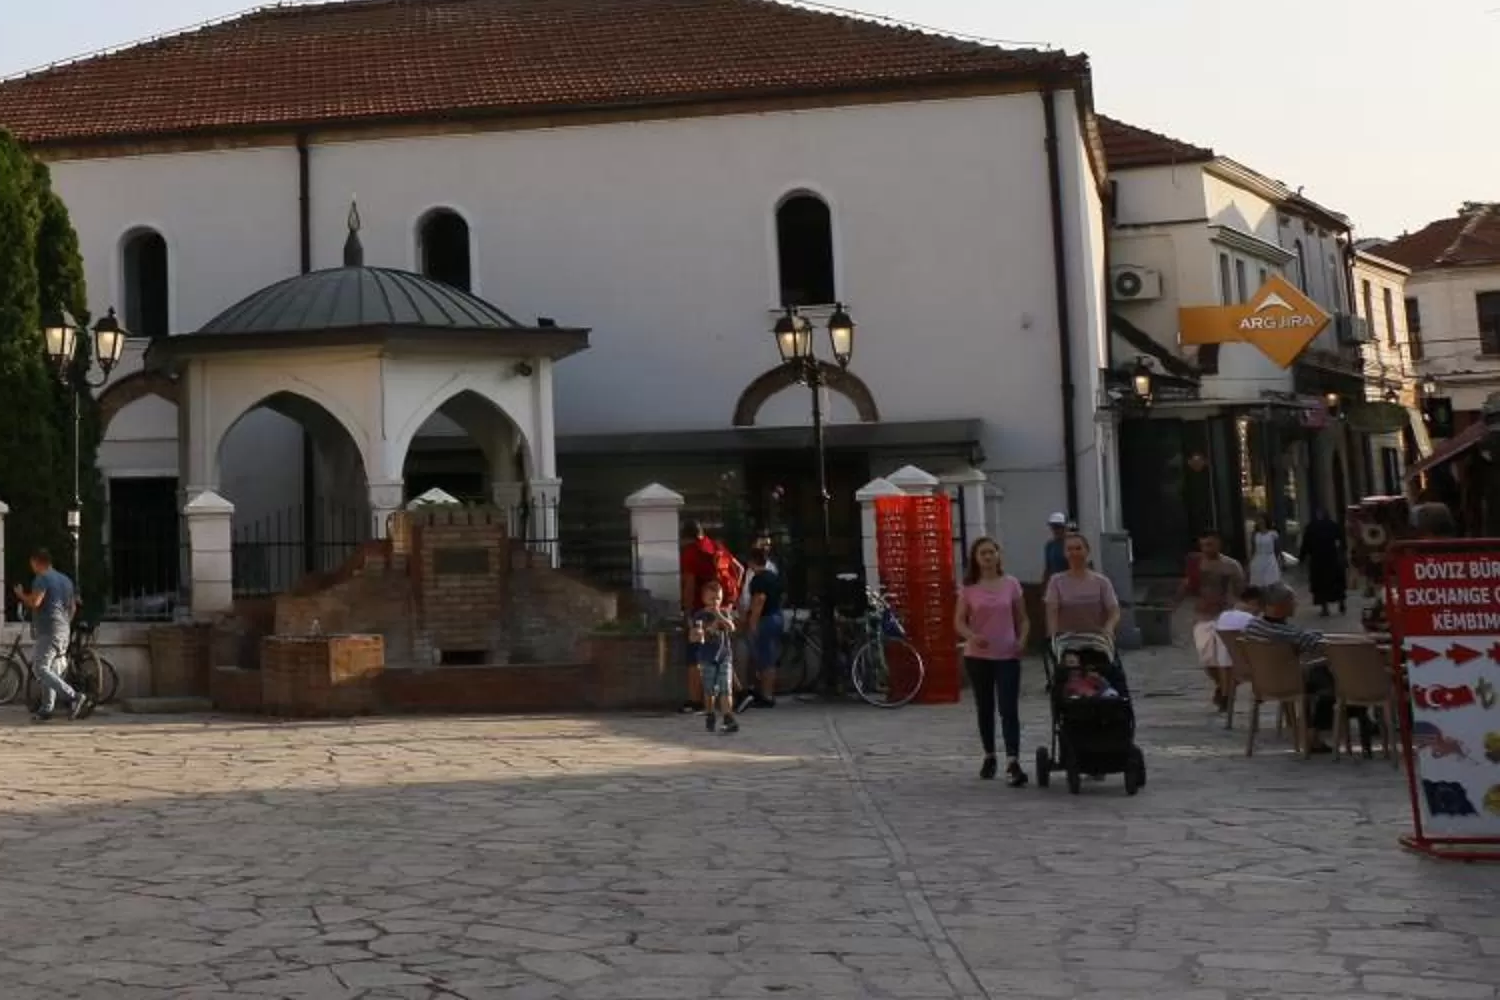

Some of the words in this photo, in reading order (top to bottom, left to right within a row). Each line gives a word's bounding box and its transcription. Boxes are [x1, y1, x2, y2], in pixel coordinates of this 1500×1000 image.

[1414, 557, 1467, 580] DÖVIZ
[1405, 586, 1492, 606] EXCHANGE
[1431, 609, 1500, 632] KËMBIM
